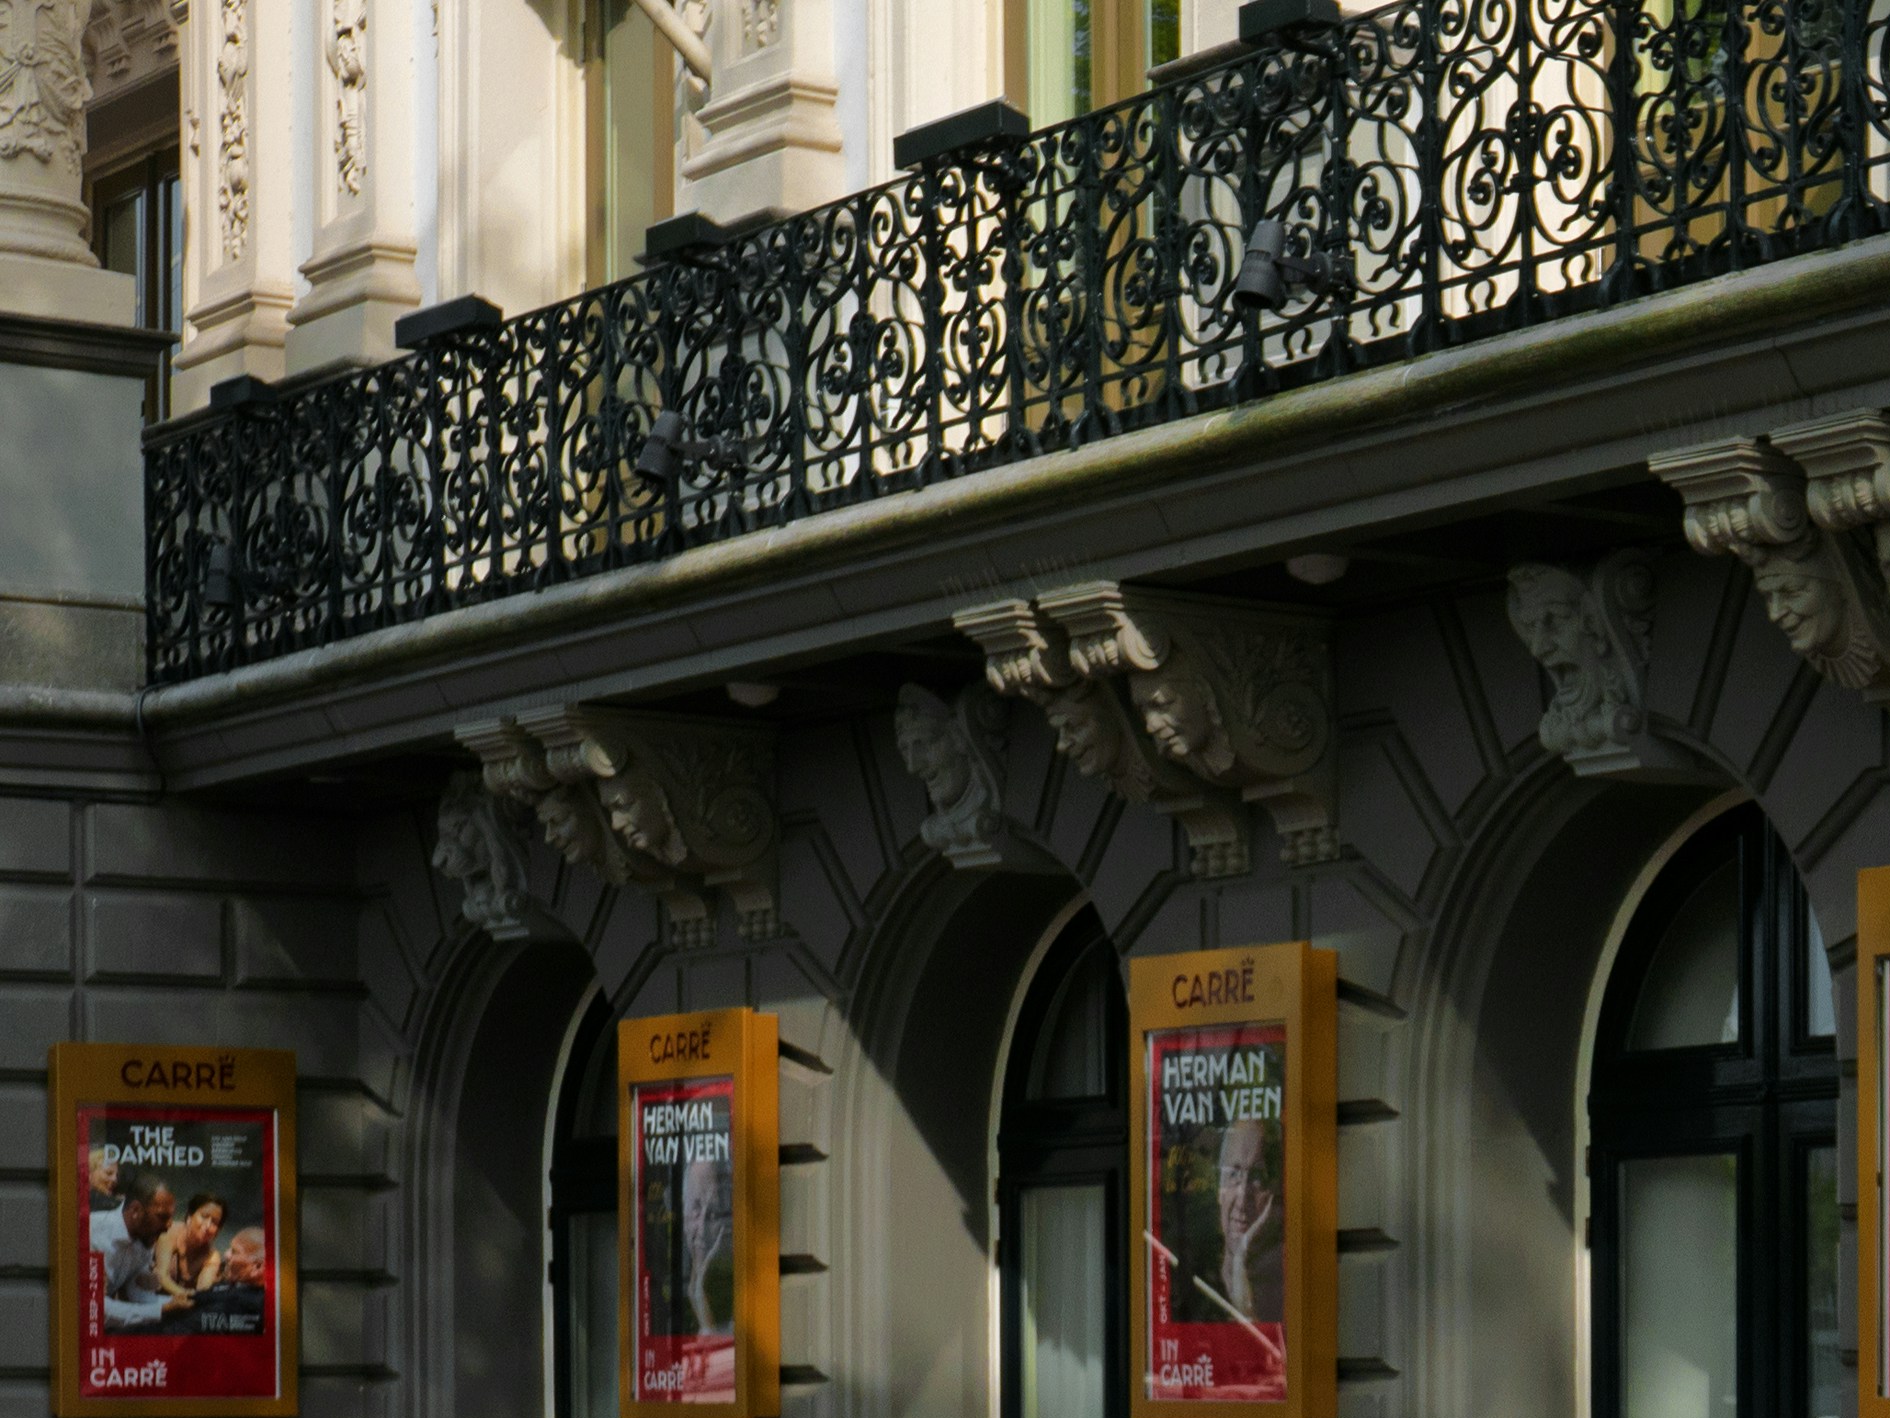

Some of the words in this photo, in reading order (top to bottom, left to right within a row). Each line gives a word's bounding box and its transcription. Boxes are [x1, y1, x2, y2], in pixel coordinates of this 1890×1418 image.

[1163, 1051, 1266, 1090] HERMAN
[643, 1102, 714, 1135] HERMAN
[1164, 1091, 1214, 1126] VAN
[1220, 1086, 1282, 1122] VEEN
[130, 1125, 175, 1146] THE
[645, 1136, 679, 1166] VAN
[684, 1131, 730, 1163] VEEN
[104, 1144, 204, 1167] DAMNED
[91, 1348, 115, 1367] IN
[1161, 1338, 1179, 1363] IN
